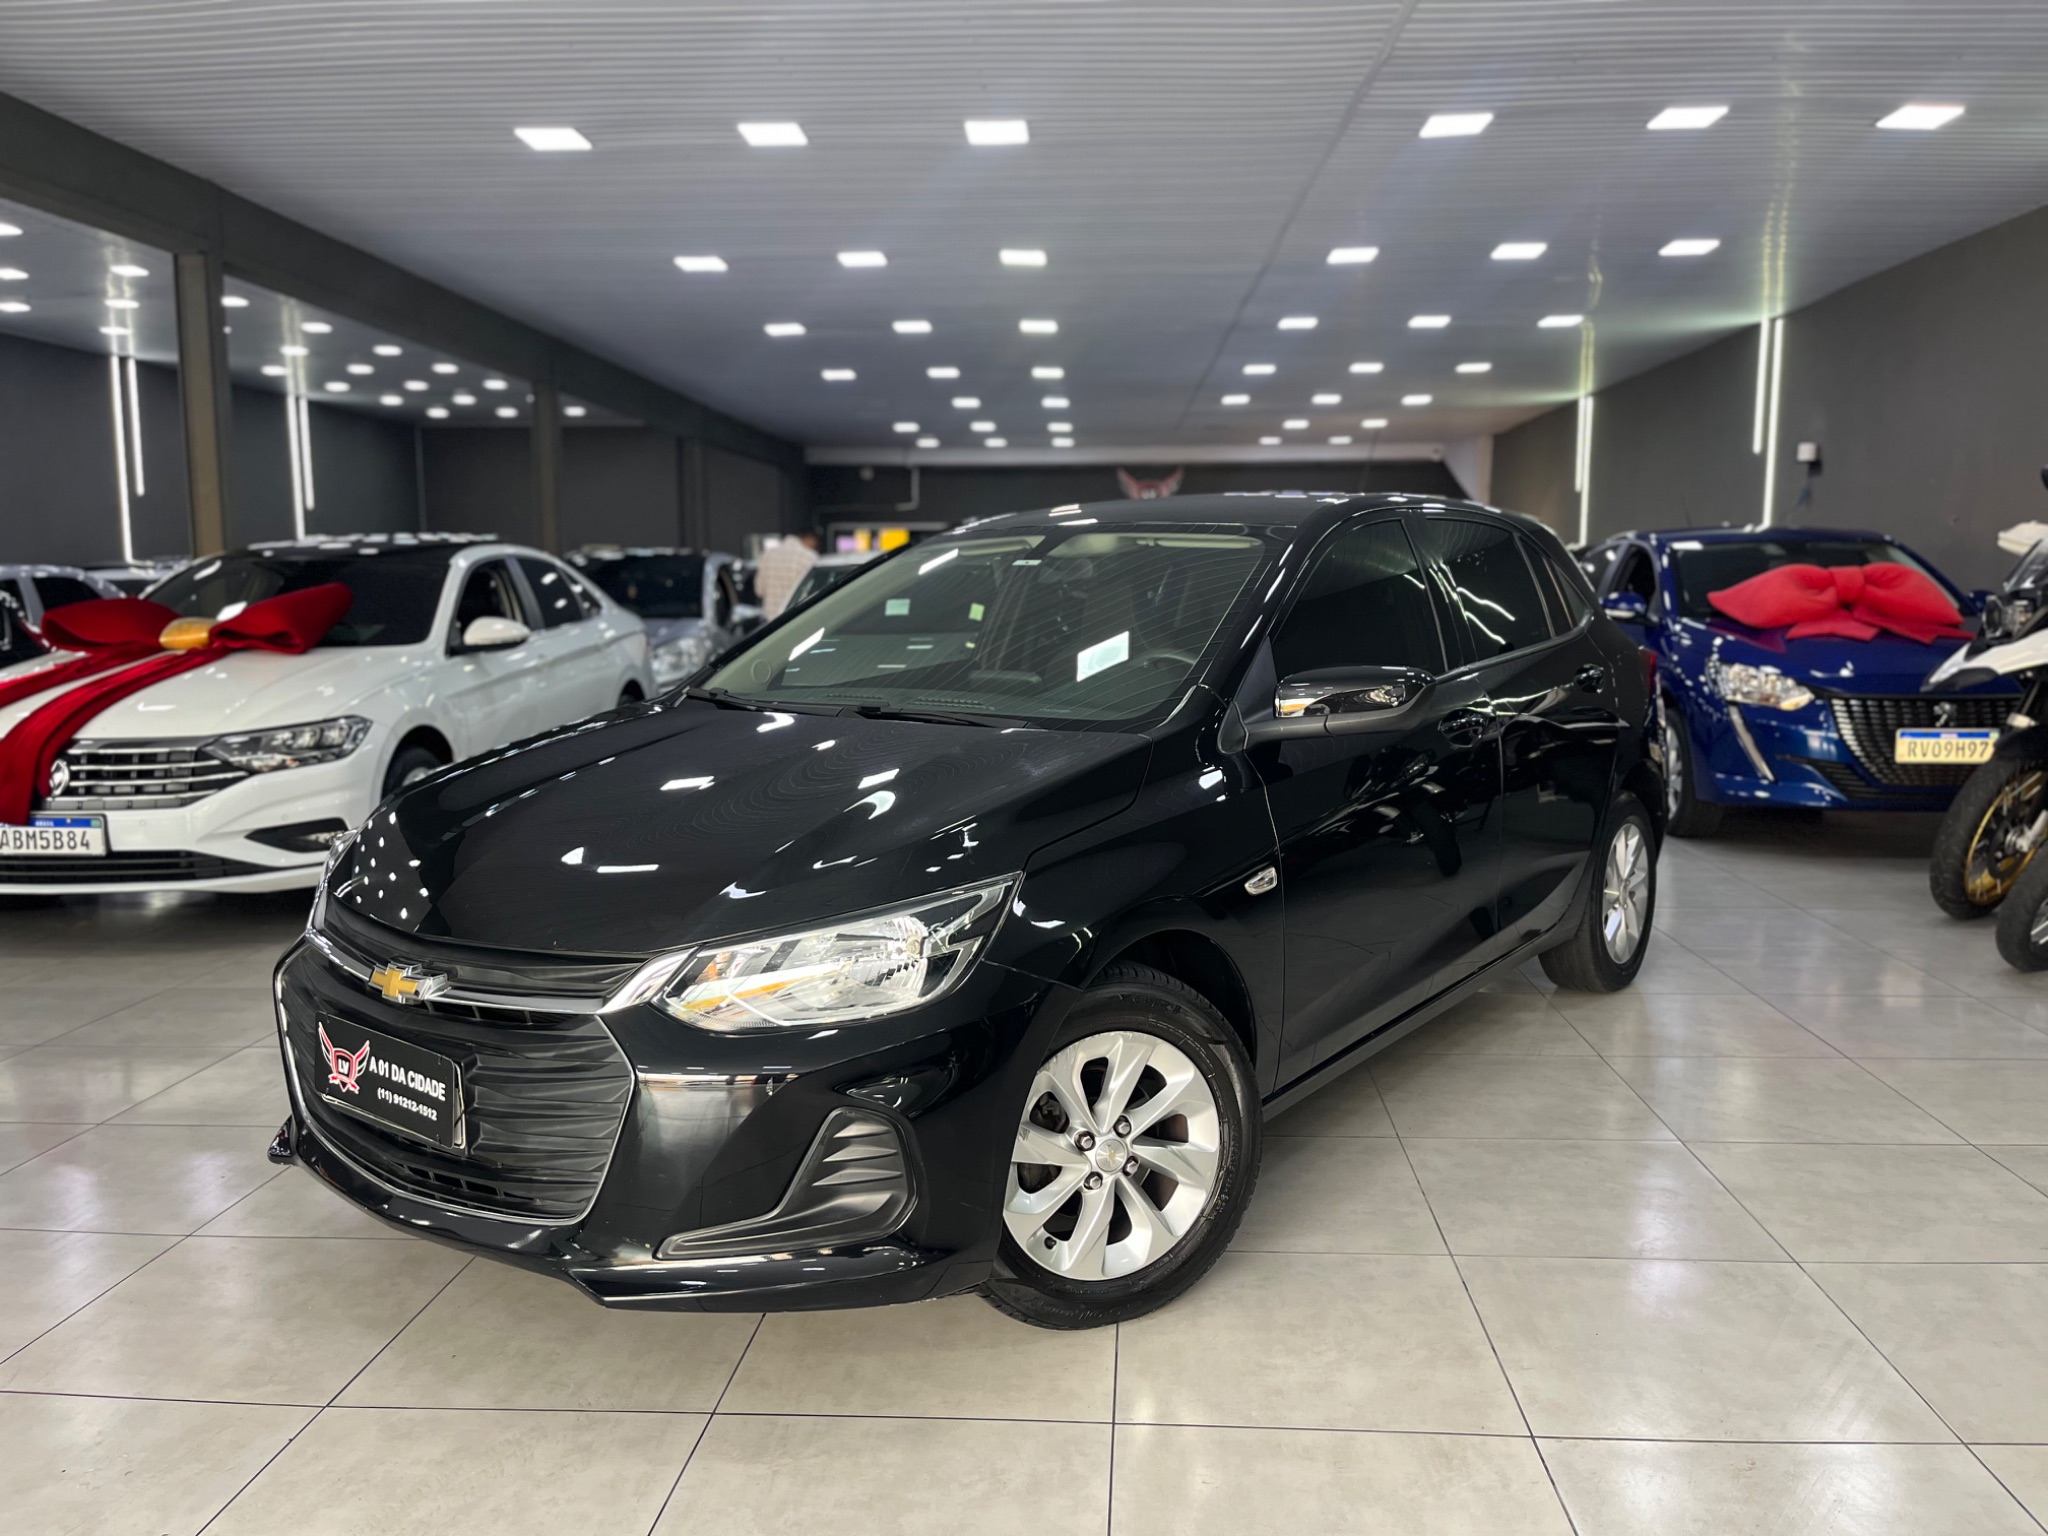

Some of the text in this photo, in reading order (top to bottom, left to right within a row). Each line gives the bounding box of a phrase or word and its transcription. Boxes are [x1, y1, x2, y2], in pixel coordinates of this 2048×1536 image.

[0, 830, 90, 850] ABM5B84
[369, 1056, 446, 1101] A 01 DA CIDADE
[377, 1087, 438, 1121] (11) 91212-1512
